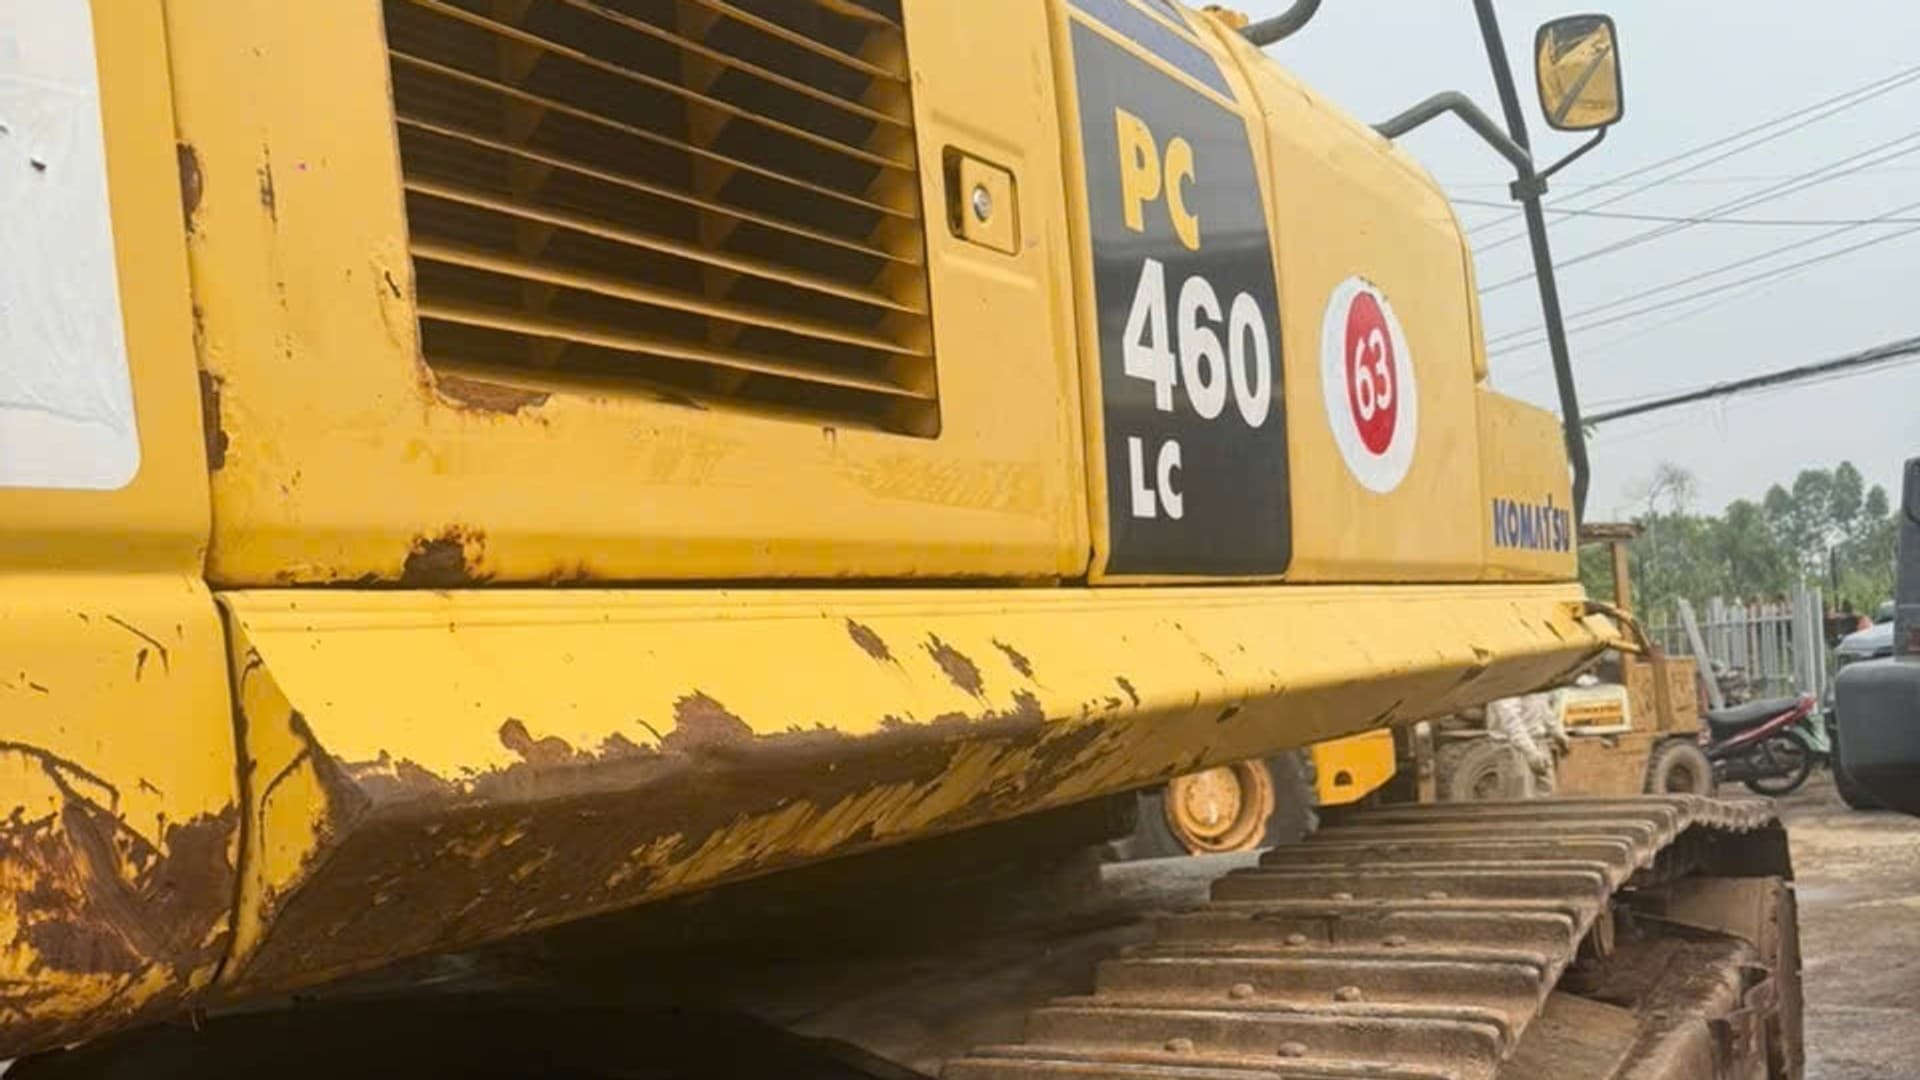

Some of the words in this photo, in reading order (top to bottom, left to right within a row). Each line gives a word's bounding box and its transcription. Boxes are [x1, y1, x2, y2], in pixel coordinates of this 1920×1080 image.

[1115, 107, 1200, 250] PC
[1123, 258, 1271, 428] 460
[1355, 328, 1393, 421] 63
[1128, 437, 1184, 520] LC
[1493, 494, 1569, 552] KOMATSU
